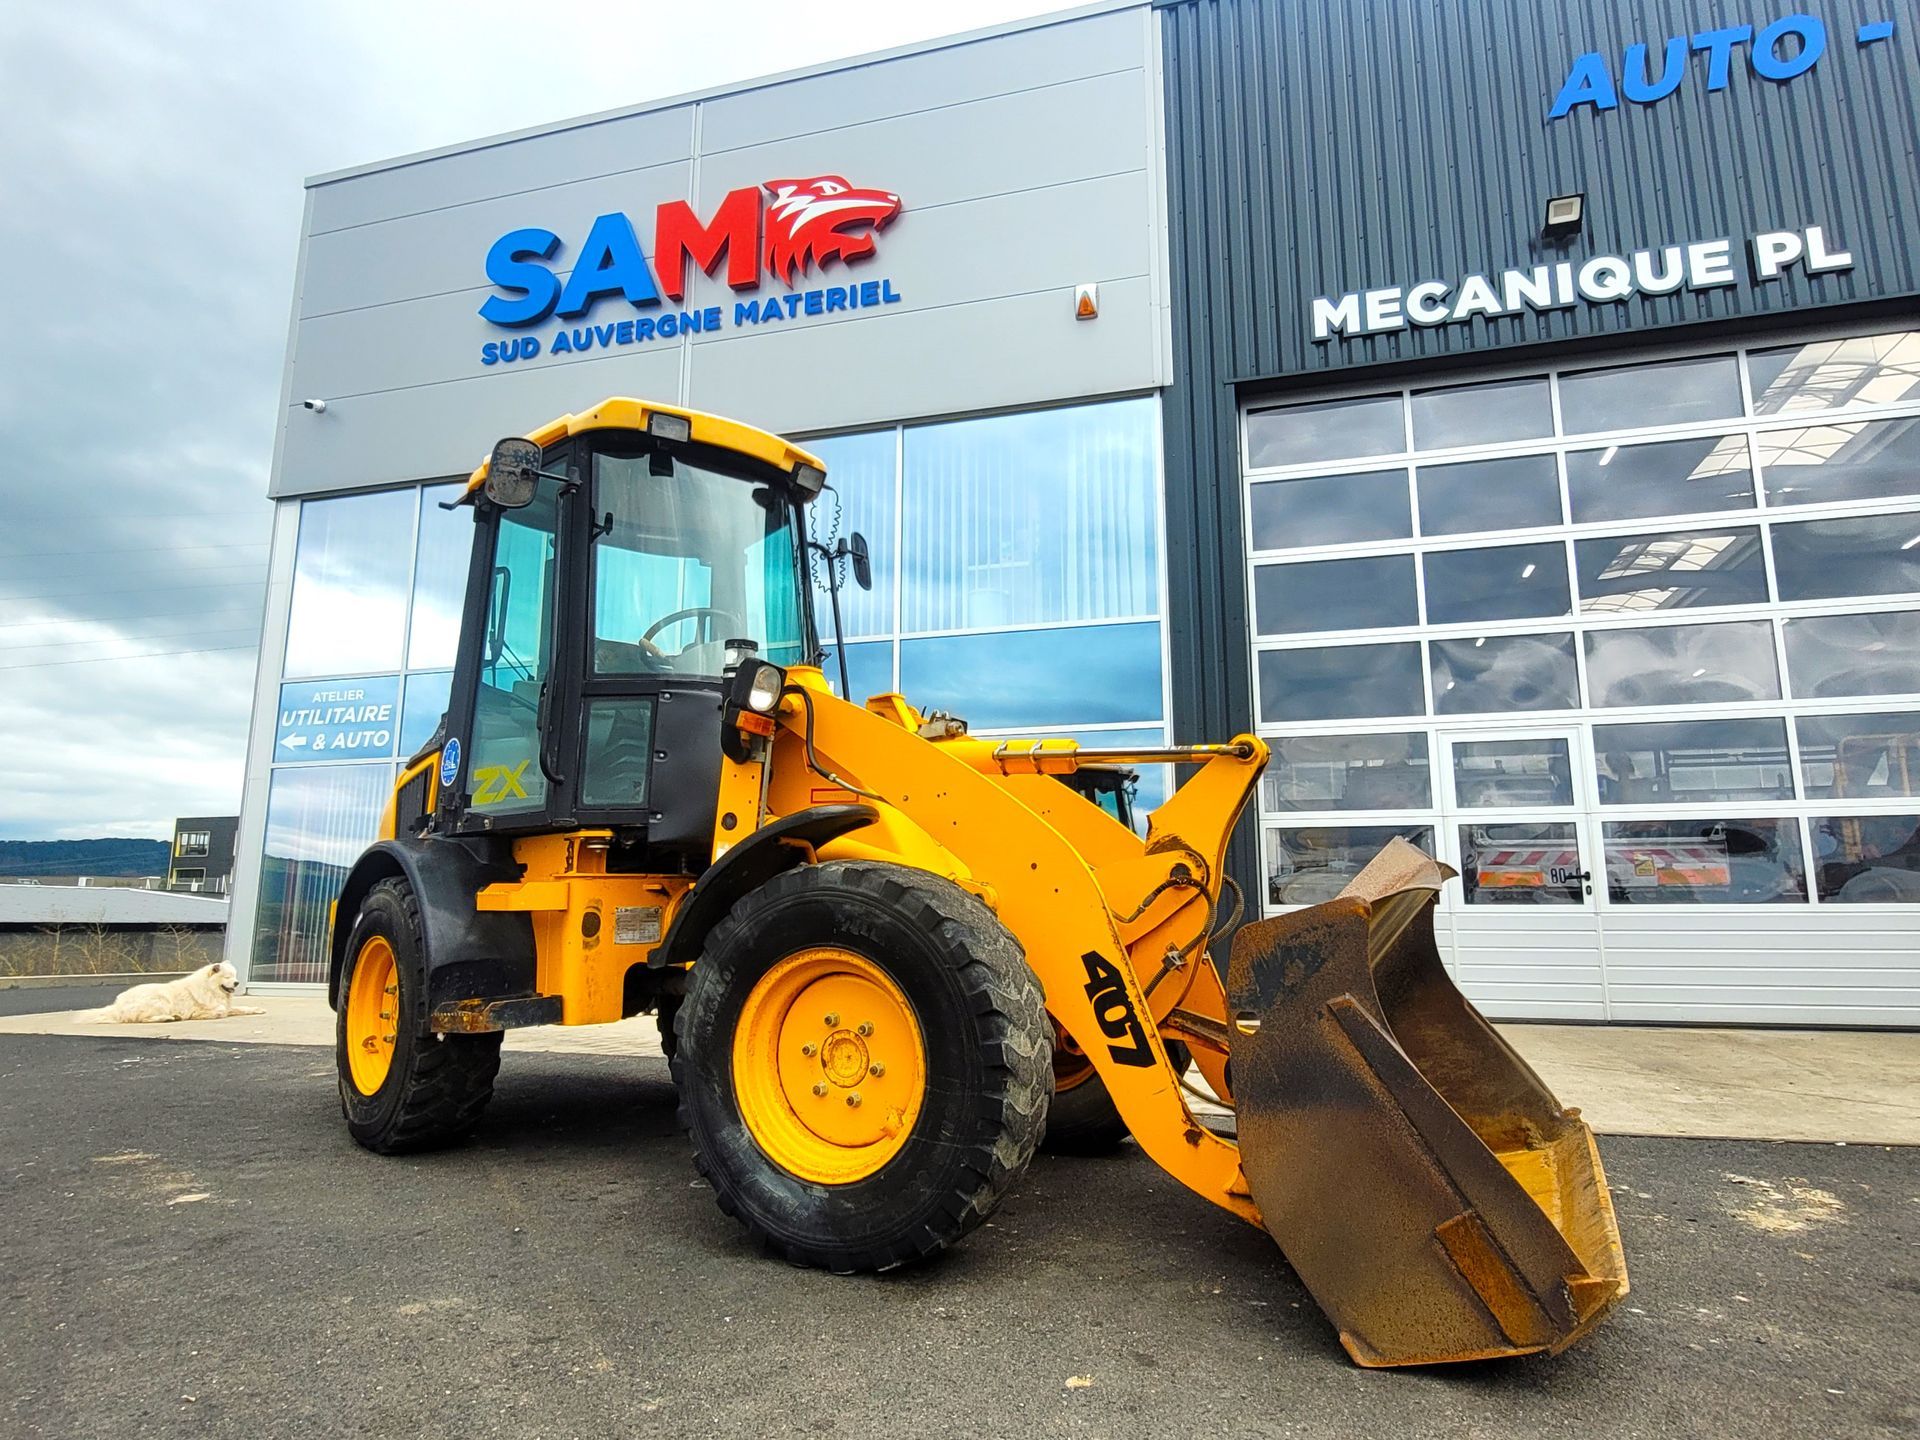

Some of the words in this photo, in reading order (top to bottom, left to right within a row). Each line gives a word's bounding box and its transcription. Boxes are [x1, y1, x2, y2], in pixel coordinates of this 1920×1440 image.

[1549, 13, 1826, 118] AUTO
[478, 185, 763, 328] SAM
[1311, 239, 1736, 341] MECANIQUE
[1755, 226, 1853, 279] PL
[481, 336, 541, 366] SUD
[550, 306, 722, 355] AUVERGNE
[734, 279, 902, 328] MATERIEL
[281, 704, 393, 727] UTILITAIRE
[312, 689, 365, 703] ATELIER
[312, 733, 327, 751] &
[330, 729, 391, 750] AUTO
[471, 759, 531, 807] ZX
[1081, 950, 1158, 1068] 407
